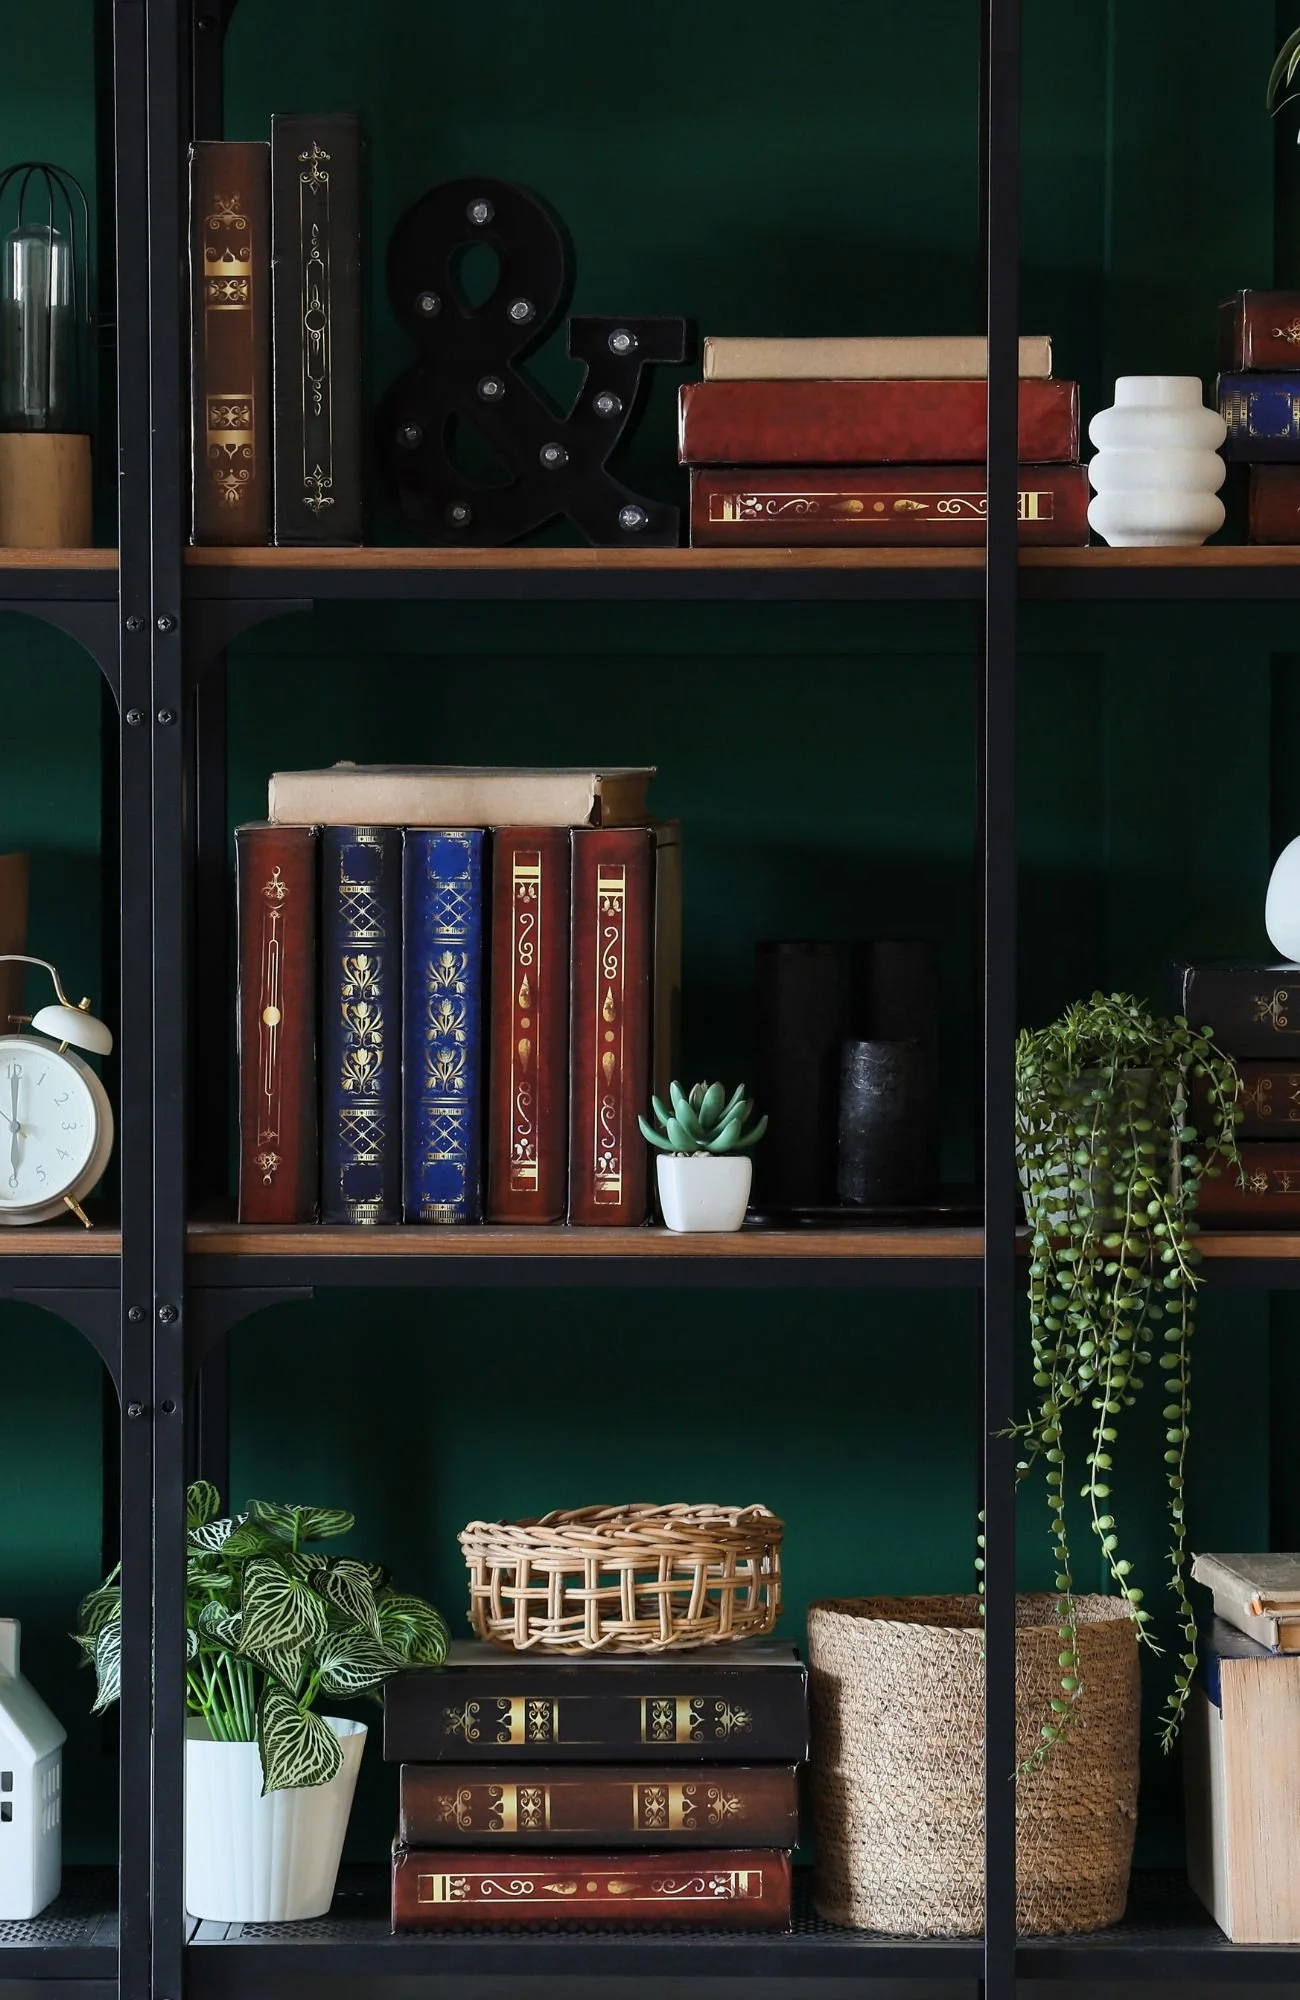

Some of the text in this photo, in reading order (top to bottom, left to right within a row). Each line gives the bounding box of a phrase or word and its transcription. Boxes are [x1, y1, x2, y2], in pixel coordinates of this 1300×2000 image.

[378, 175, 690, 547] &
[6, 1063, 23, 1080] 12
[36, 1072, 47, 1086] 1
[54, 1092, 70, 1107] 2
[61, 1121, 77, 1131] 3
[56, 1147, 70, 1160] 4
[36, 1164, 47, 1182] 5
[8, 1174, 19, 1189] 6
